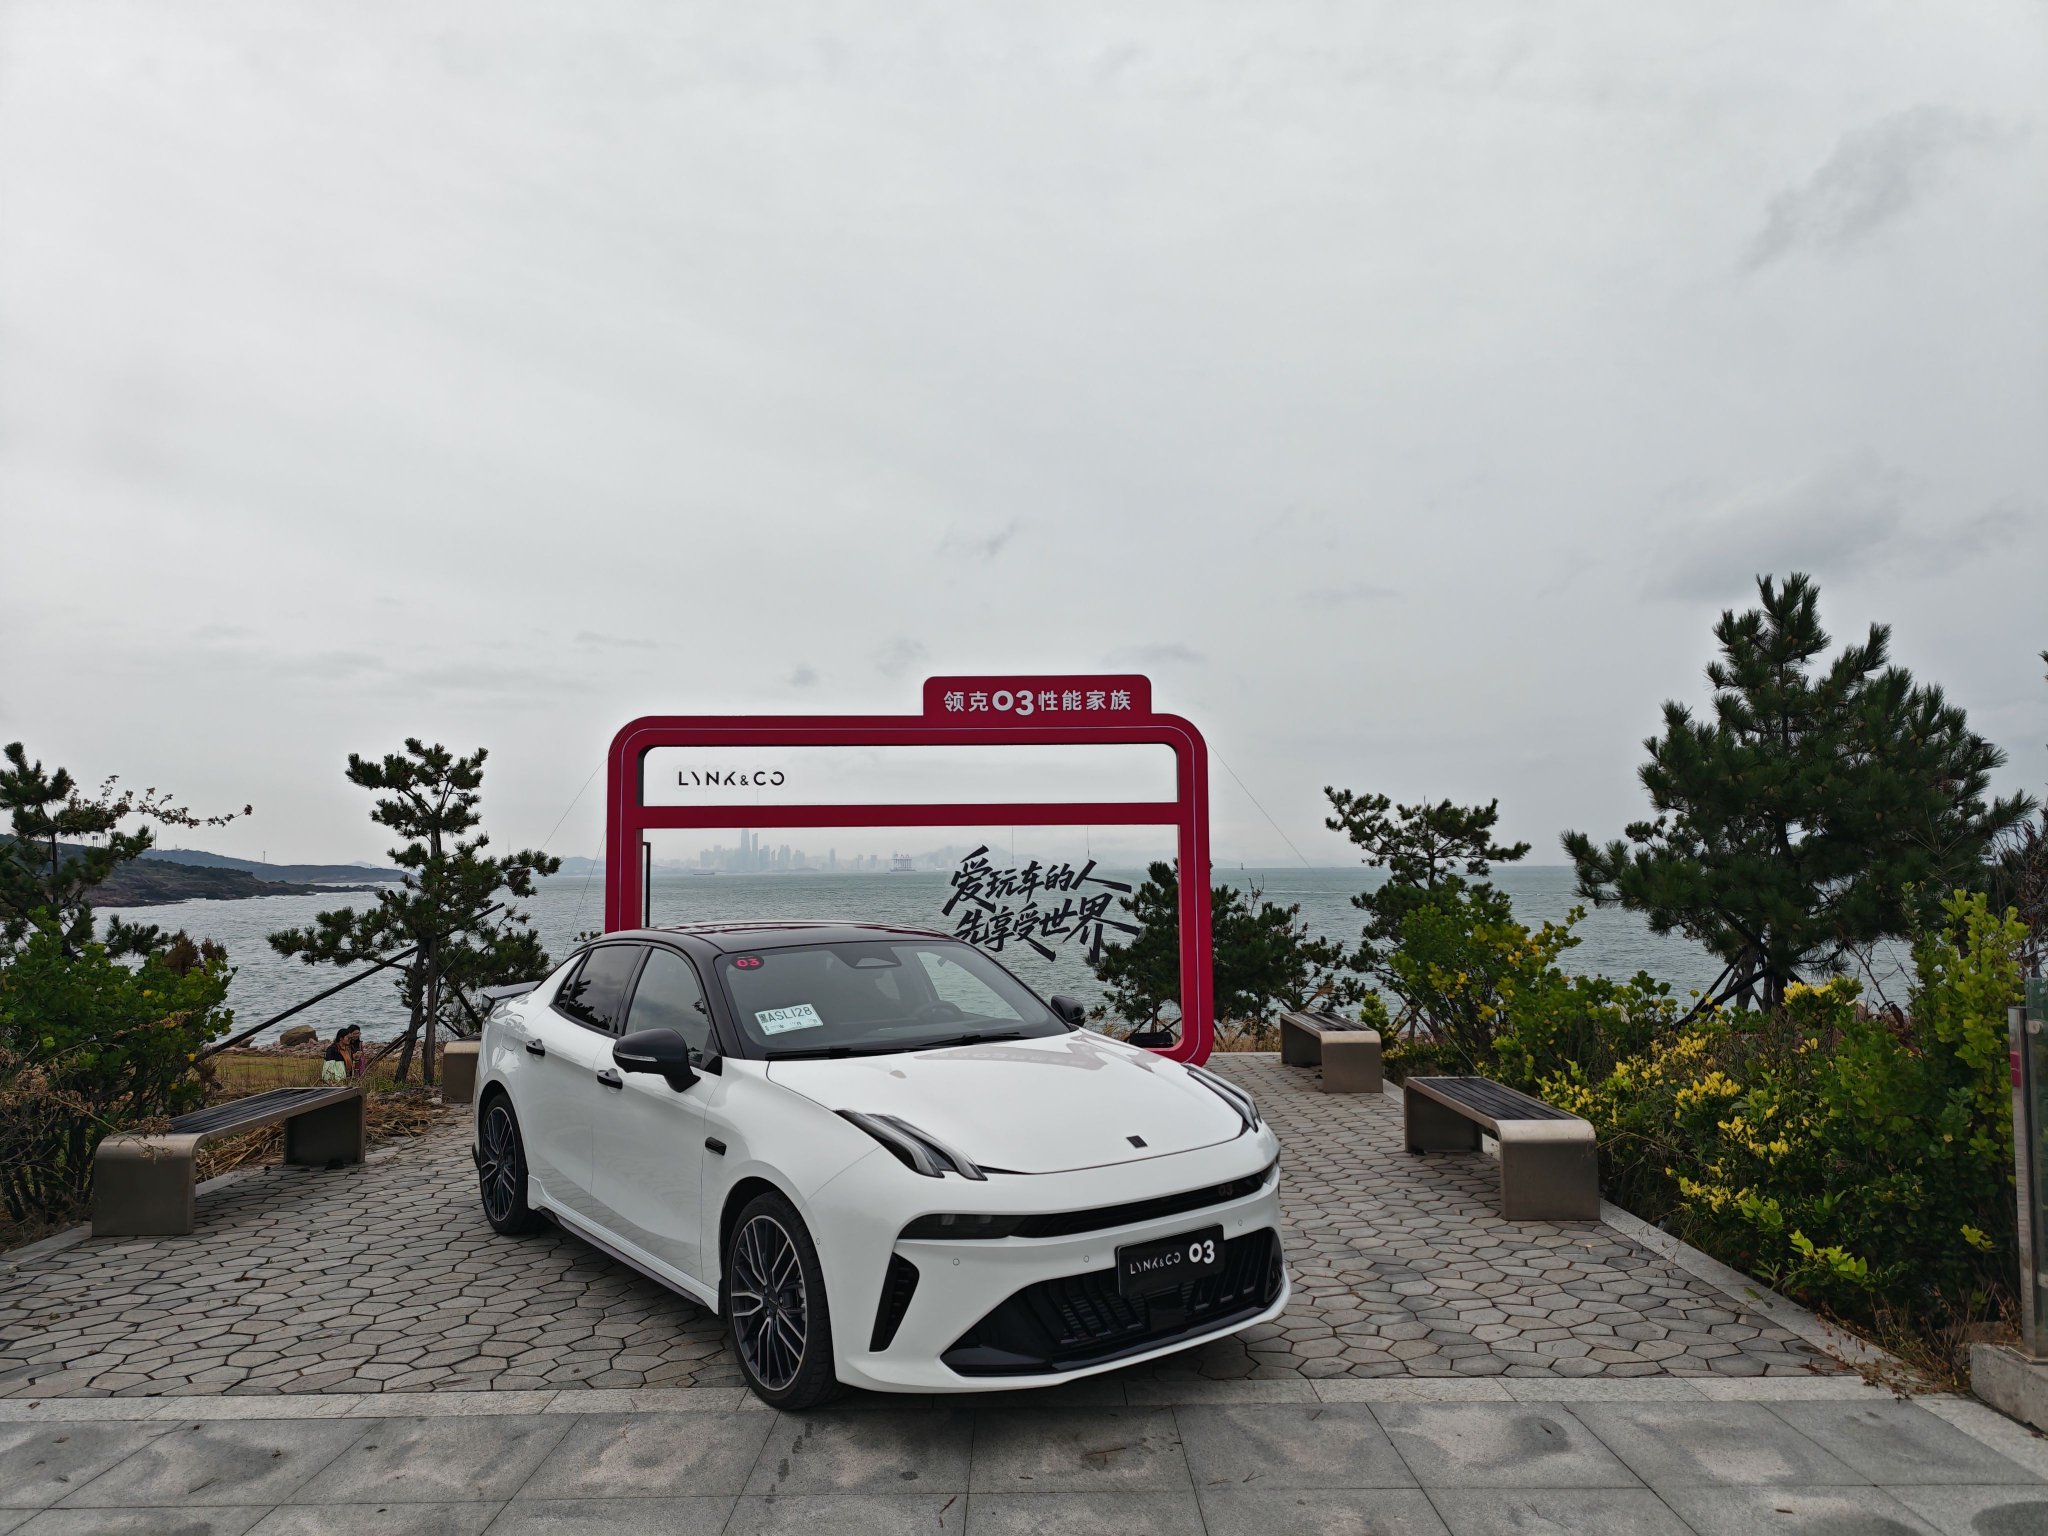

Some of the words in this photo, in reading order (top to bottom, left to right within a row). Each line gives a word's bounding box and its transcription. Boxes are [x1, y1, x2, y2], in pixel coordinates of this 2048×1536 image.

[943, 689, 1132, 716] 领克03性能家族
[678, 771, 785, 786] LYNK&CO
[942, 844, 1132, 917] 爱玩车的人
[953, 892, 1141, 964] 先享受世界
[736, 958, 760, 968] 03
[1130, 1252, 1181, 1275] LYNK&CO
[1188, 1239, 1215, 1264] 03
